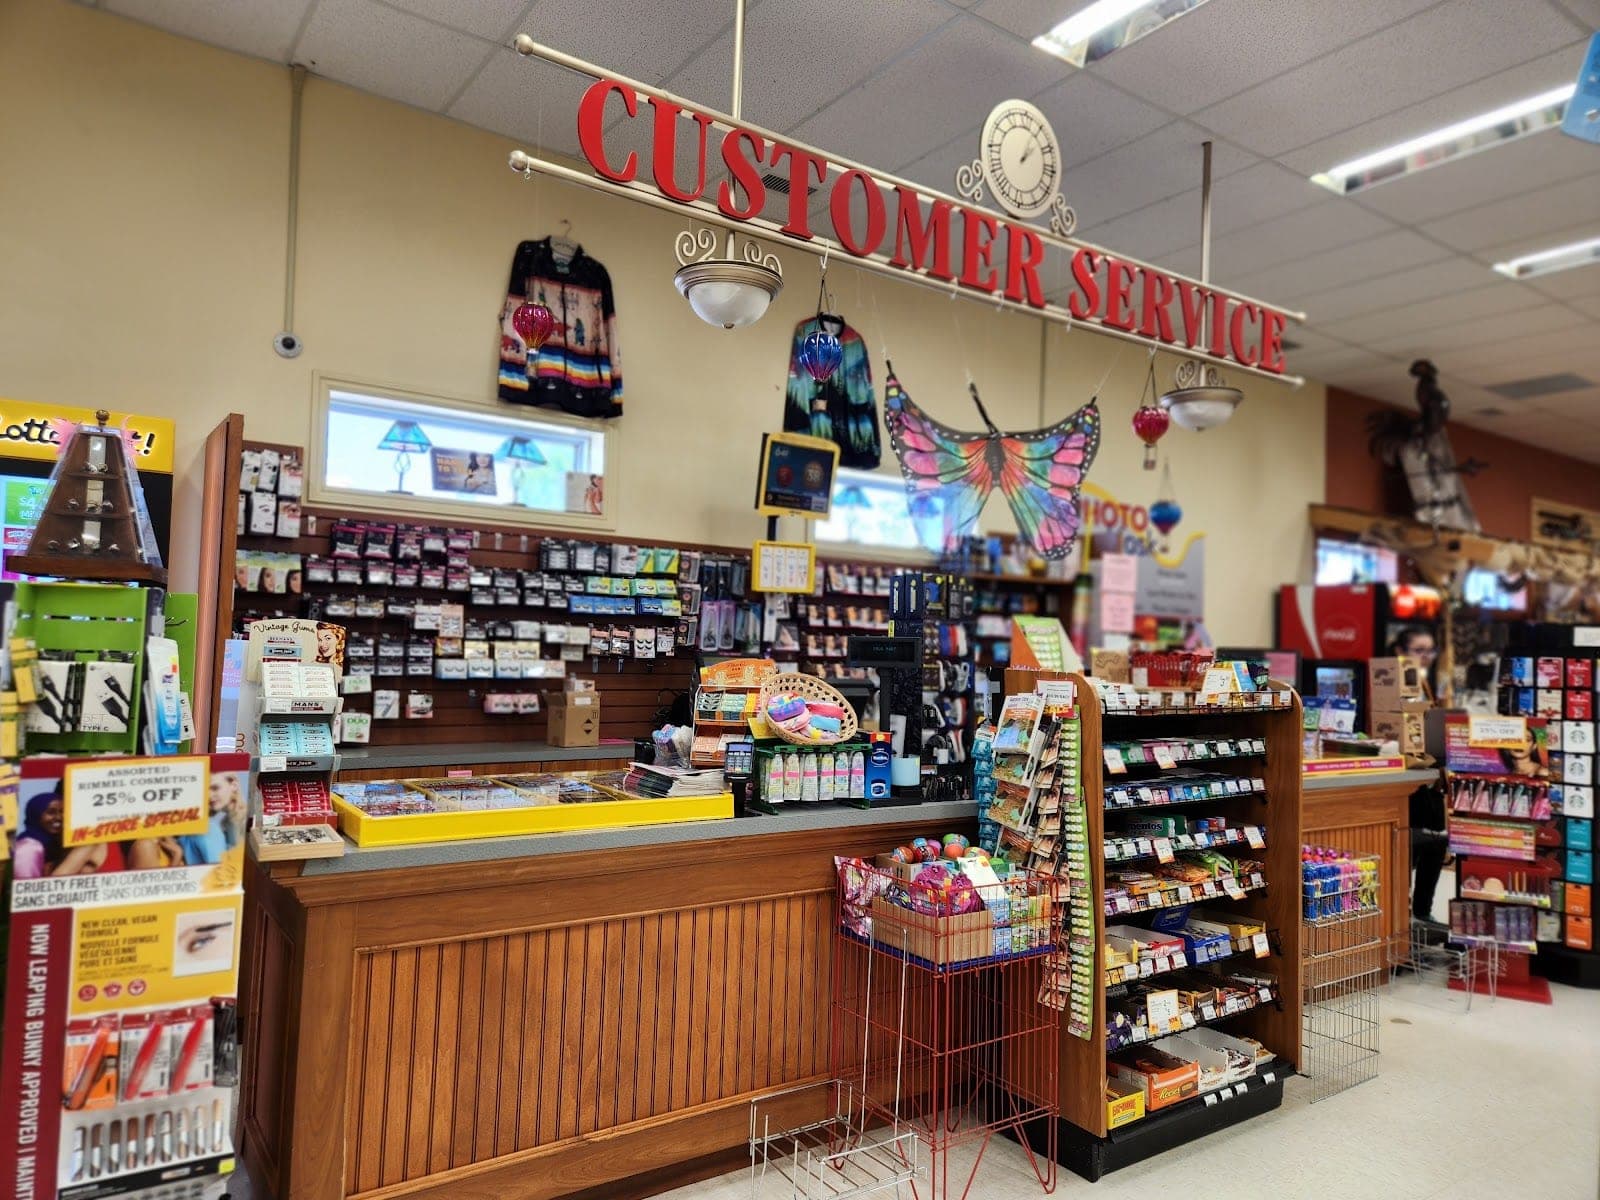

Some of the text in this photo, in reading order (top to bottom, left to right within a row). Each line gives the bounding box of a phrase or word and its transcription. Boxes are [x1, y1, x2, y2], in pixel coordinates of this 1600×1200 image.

[577, 78, 1288, 374] CUSTOMER SERVICE
[253, 623, 289, 633] Vintage
[107, 766, 171, 777] ASSORTED
[78, 775, 198, 790] RIMMEL COSMETICS
[92, 787, 184, 807] 25% OFF
[71, 807, 201, 843] IN-STORE SPECIAL
[1128, 822, 1163, 830] mentos
[15, 869, 190, 894] CRUELTY FREE NO COMPROMISE
[14, 894, 44, 908] SANS
[102, 887, 130, 900] SANS
[132, 881, 198, 897] COMPROMIS
[81, 920, 99, 929] NEW
[132, 915, 158, 924] VEGAN
[30, 923, 49, 955] NOW
[80, 928, 119, 938] FORMULA
[80, 934, 160, 949] NOUVELLE FORMULE
[79, 954, 137, 968] PURE ET SAINE
[26, 959, 48, 1018] LEAPING
[22, 1024, 45, 1068] BUNNY
[17, 1071, 42, 1145] APPROVED
